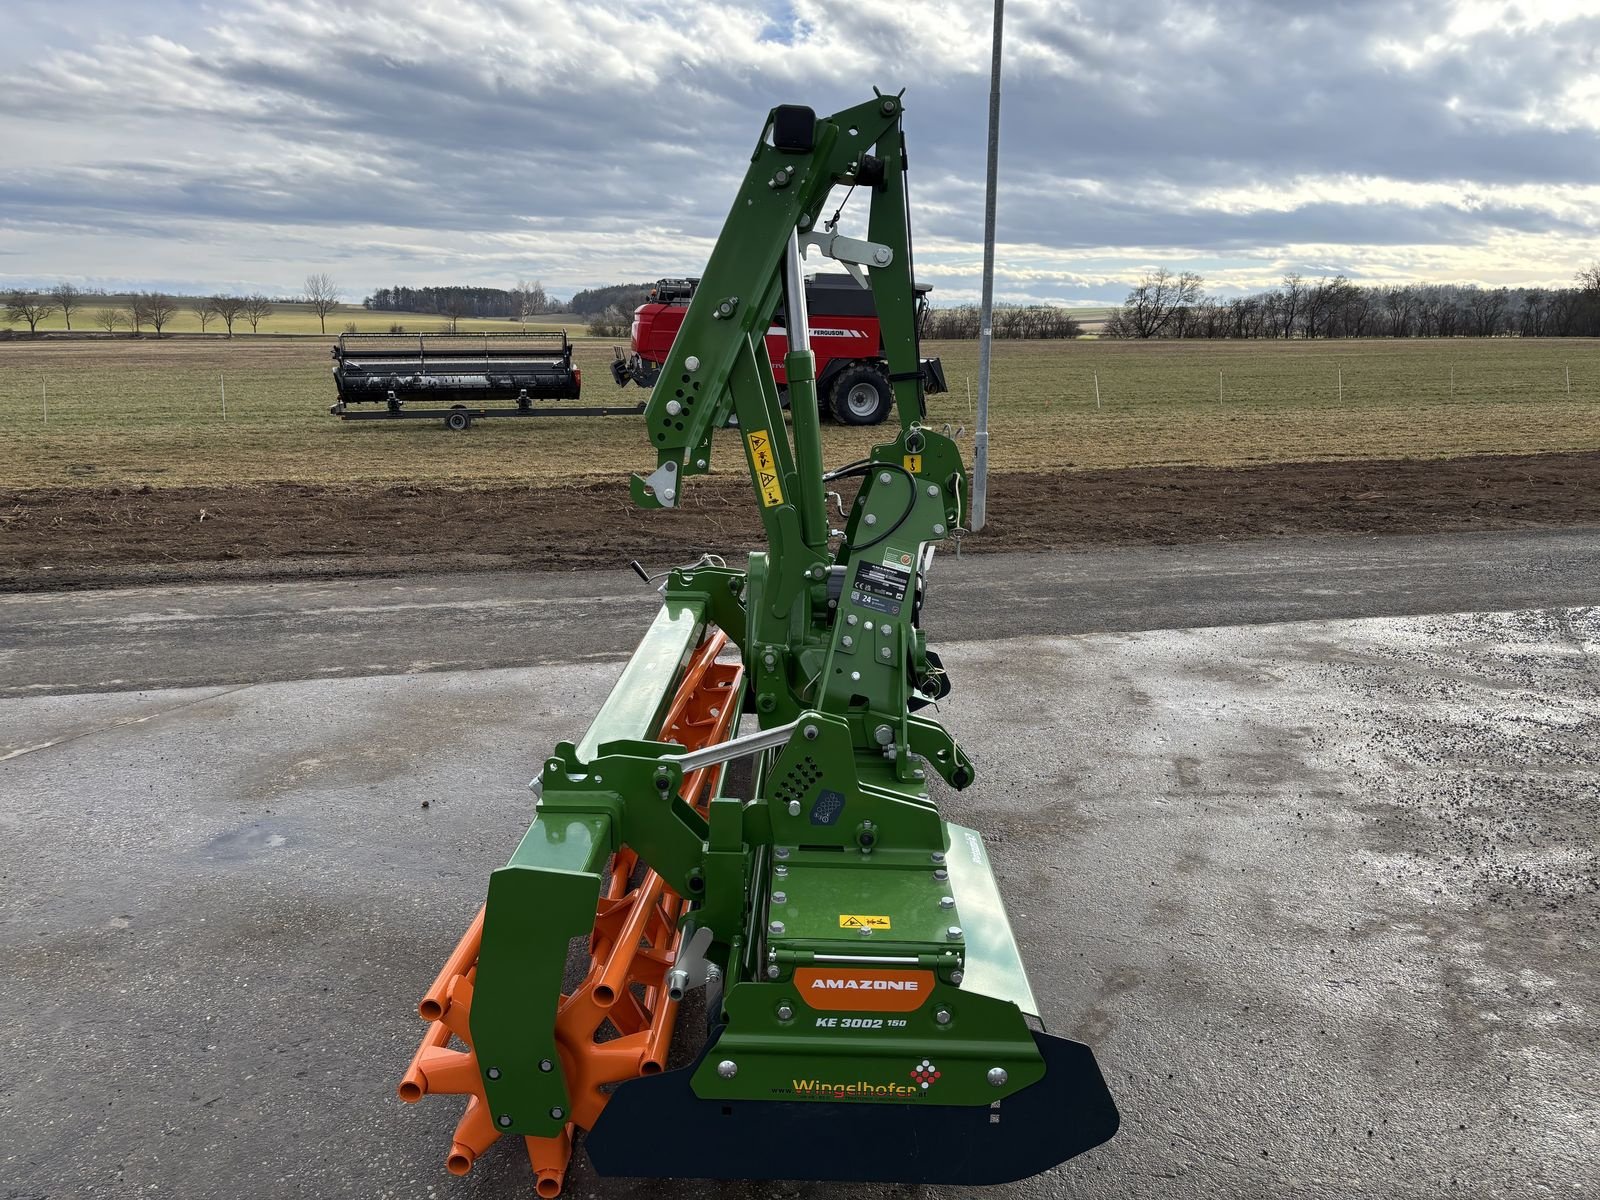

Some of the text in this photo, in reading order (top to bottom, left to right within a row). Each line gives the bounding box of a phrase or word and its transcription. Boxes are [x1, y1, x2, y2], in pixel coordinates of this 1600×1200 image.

[862, 595, 872, 603] 24
[811, 979, 918, 991] AMAZONE
[816, 1018, 838, 1027] KE
[840, 1018, 883, 1029] 3002
